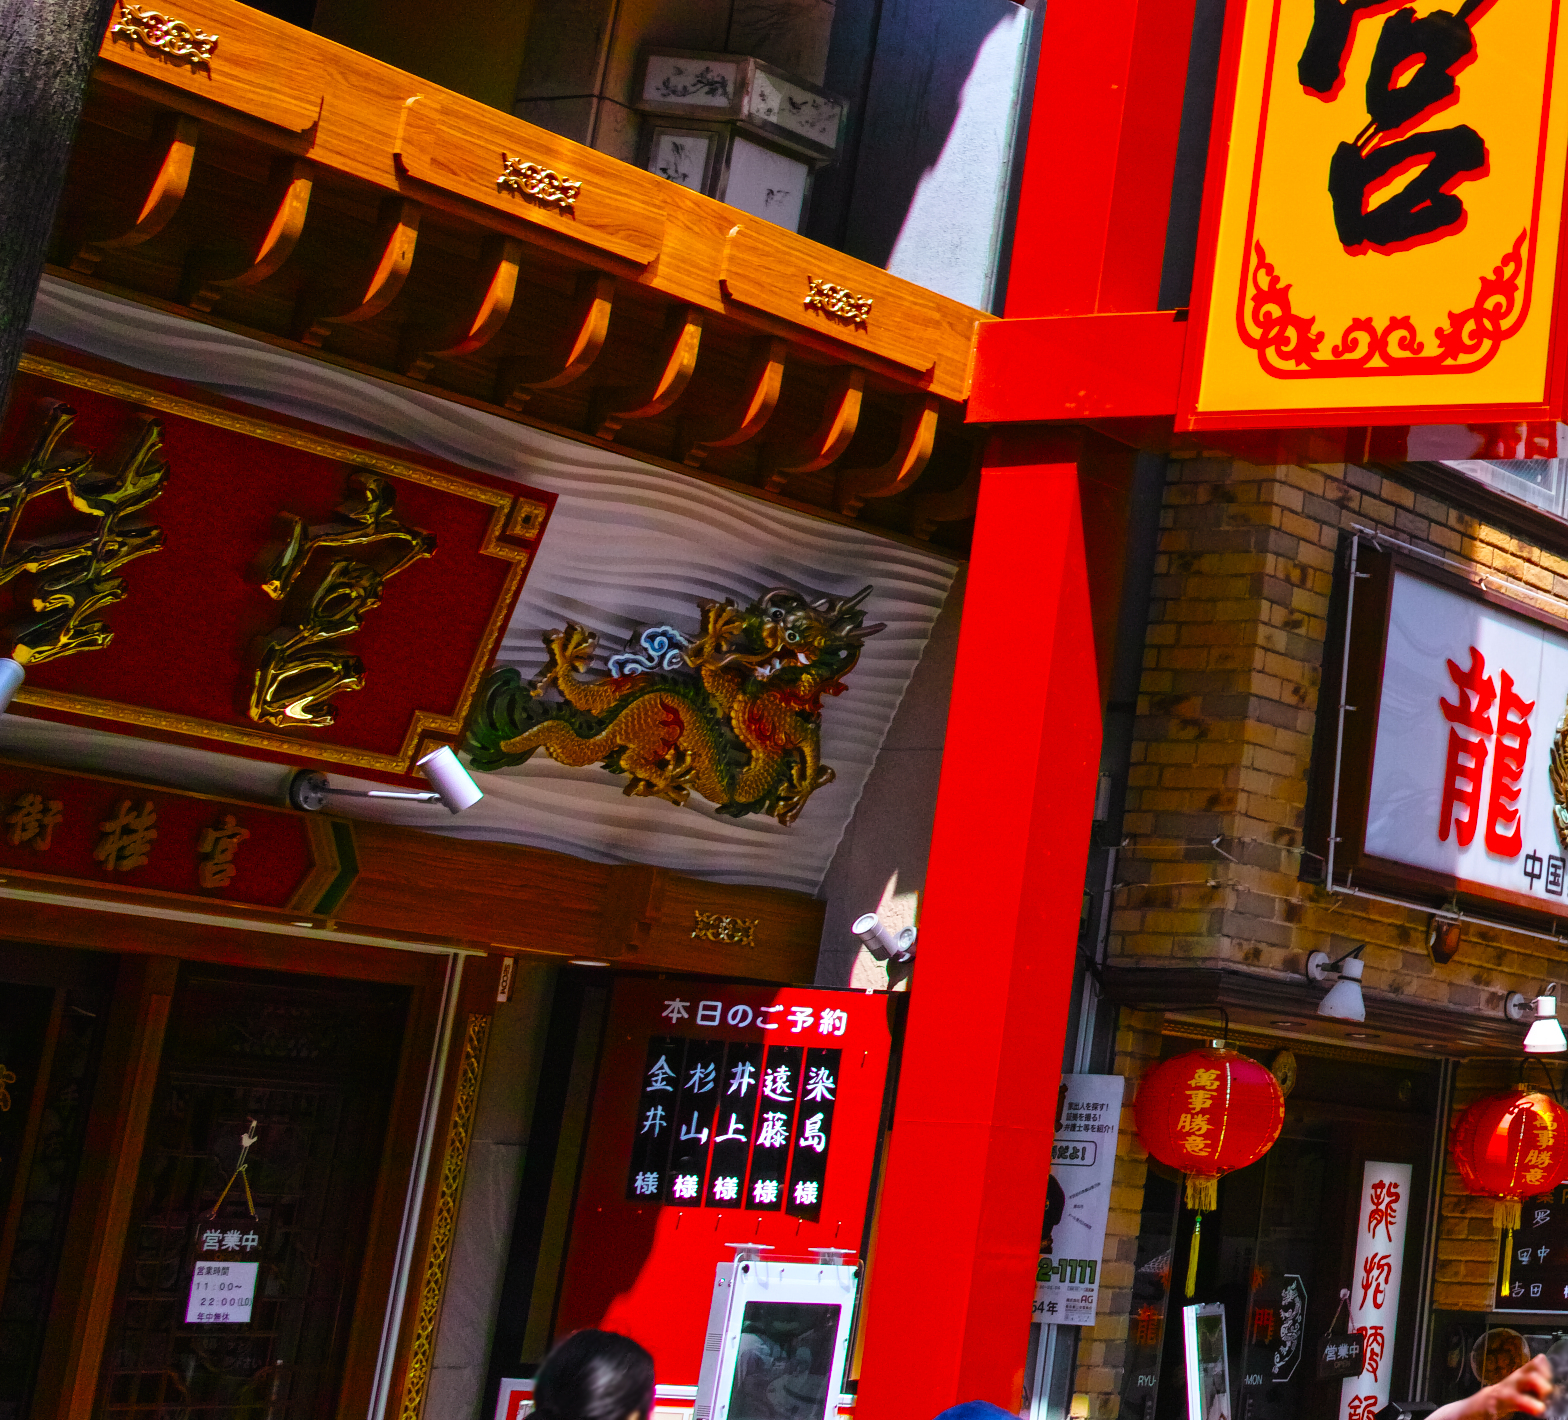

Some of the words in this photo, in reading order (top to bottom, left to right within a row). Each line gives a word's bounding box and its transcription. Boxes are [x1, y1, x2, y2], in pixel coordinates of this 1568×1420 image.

[662, 998, 848, 1036] 本日のご予約
[640, 1055, 677, 1137] 金井
[680, 1061, 717, 1145] 杉山
[714, 1061, 757, 1143] 井上
[756, 1065, 794, 1148] 遠藤
[799, 1067, 836, 1153] 染島
[1177, 1068, 1221, 1156] 萬事勝意
[1521, 1111, 1558, 1186] 萬事勝意
[634, 1171, 659, 1195] 様
[673, 1174, 699, 1199] 様
[713, 1176, 739, 1201] 様
[752, 1179, 779, 1204] 様
[793, 1180, 819, 1205] 様
[202, 1229, 259, 1252] 営業中
[196, 1266, 230, 1277] 営業時間
[196, 1312, 231, 1322] 年中無休
[1324, 1343, 1361, 1362] 営業中
